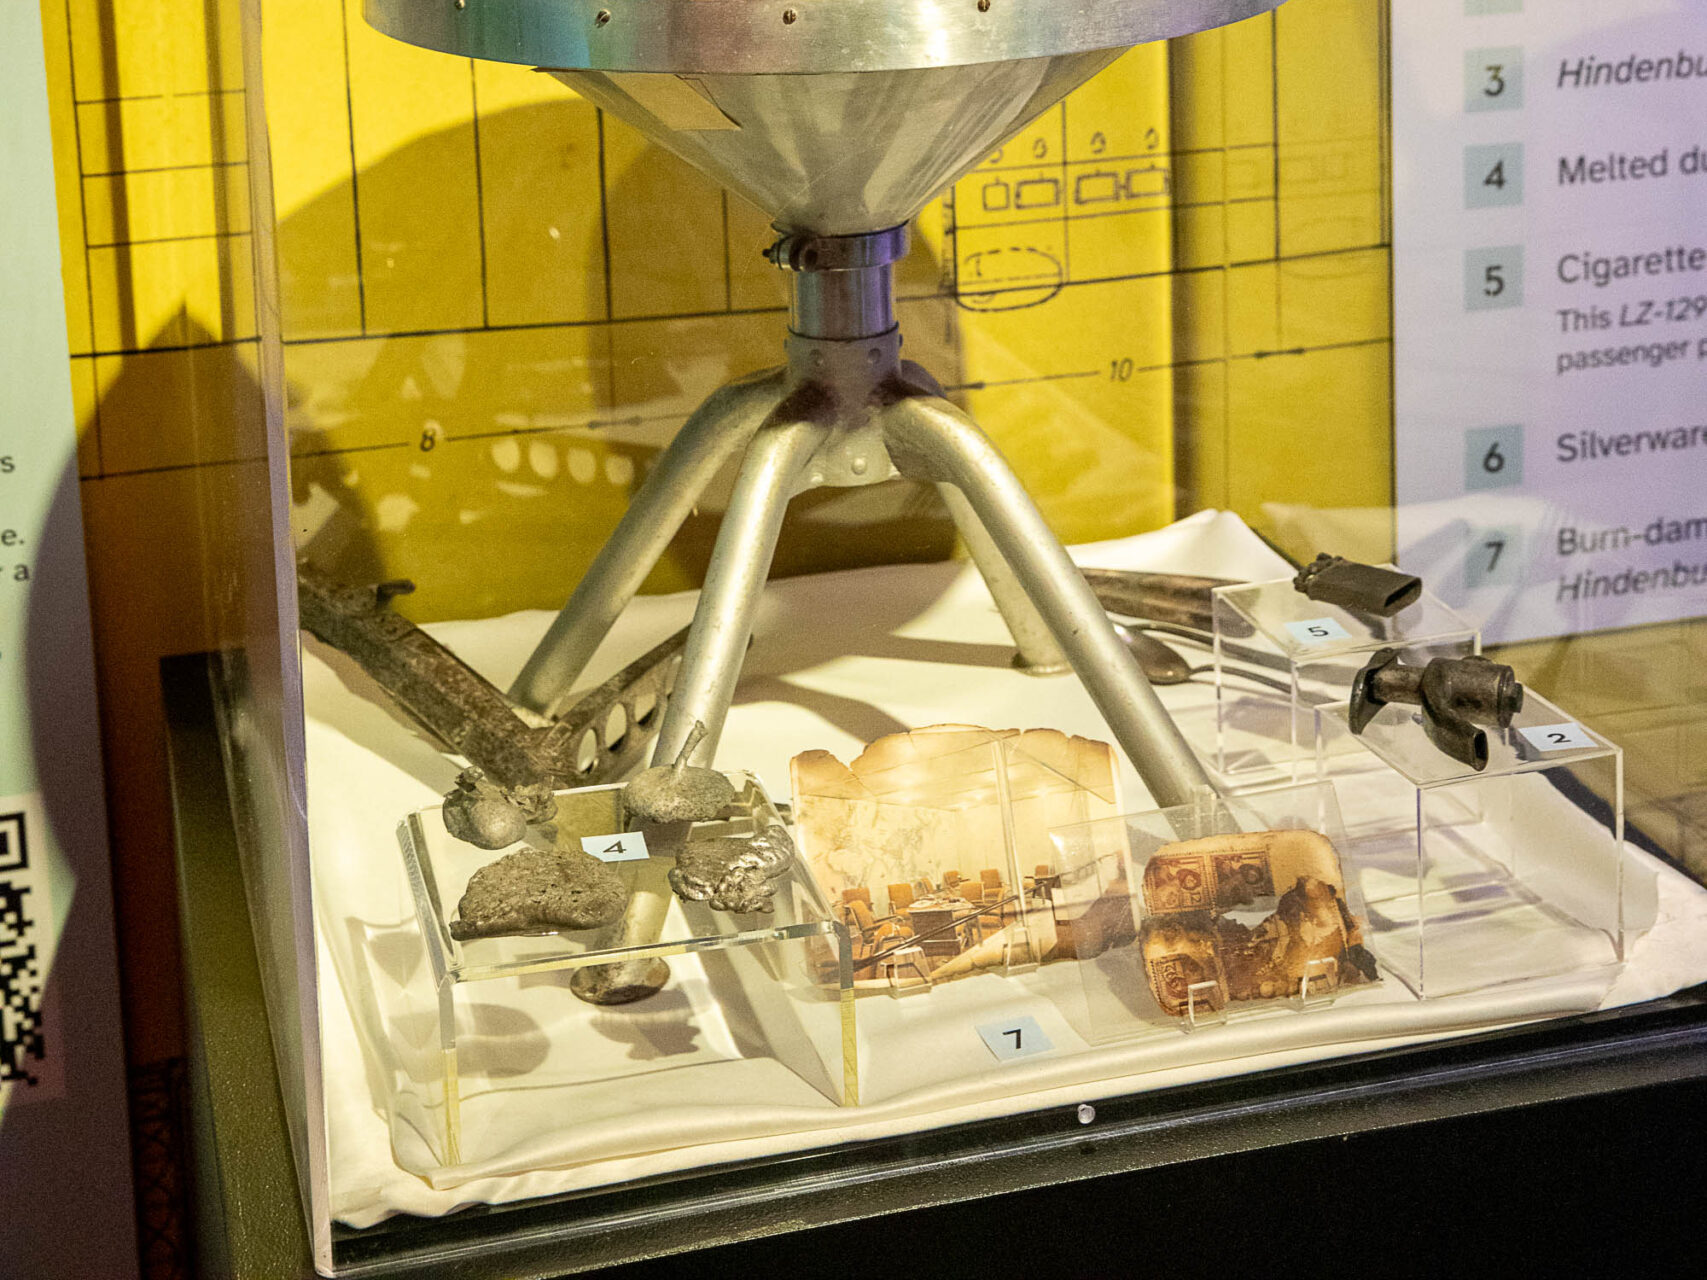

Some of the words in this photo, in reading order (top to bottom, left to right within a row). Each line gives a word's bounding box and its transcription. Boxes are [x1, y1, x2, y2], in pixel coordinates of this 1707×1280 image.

[1484, 64, 1504, 97] 3
[1483, 161, 1505, 190] 4
[1558, 146, 1668, 186] Melted
[1484, 265, 1505, 297] 5
[1557, 245, 1707, 287] Cigarette
[1556, 304, 1612, 333] This
[1109, 358, 1135, 381] 10
[1557, 339, 1690, 375] passenger
[420, 429, 436, 452] 8
[1484, 441, 1505, 473] 6
[1485, 540, 1505, 572] 7
[1307, 625, 1329, 638] 5
[1546, 732, 1572, 744] 2
[603, 839, 628, 854] 4
[1002, 1027, 1023, 1050] 7
